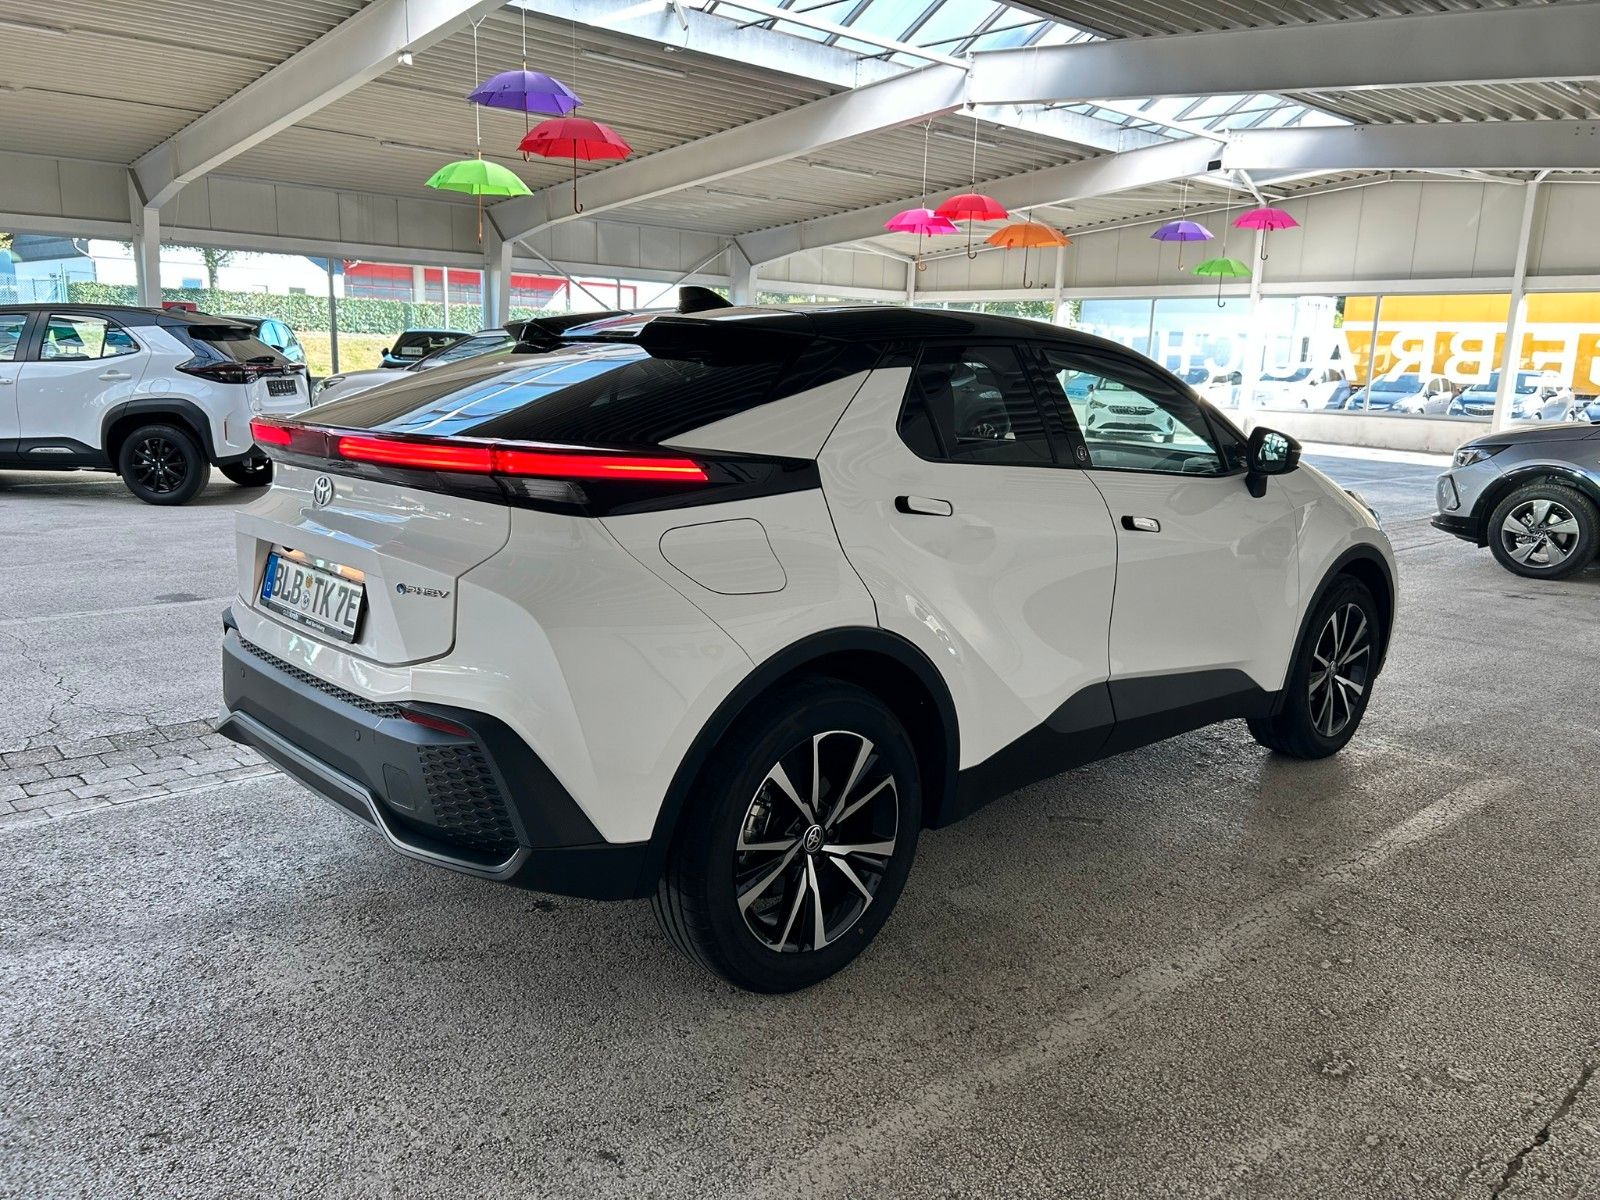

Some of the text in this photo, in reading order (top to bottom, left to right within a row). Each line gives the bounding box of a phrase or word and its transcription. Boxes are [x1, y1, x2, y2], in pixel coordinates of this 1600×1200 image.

[272, 563, 361, 628] BLB TK 7E
